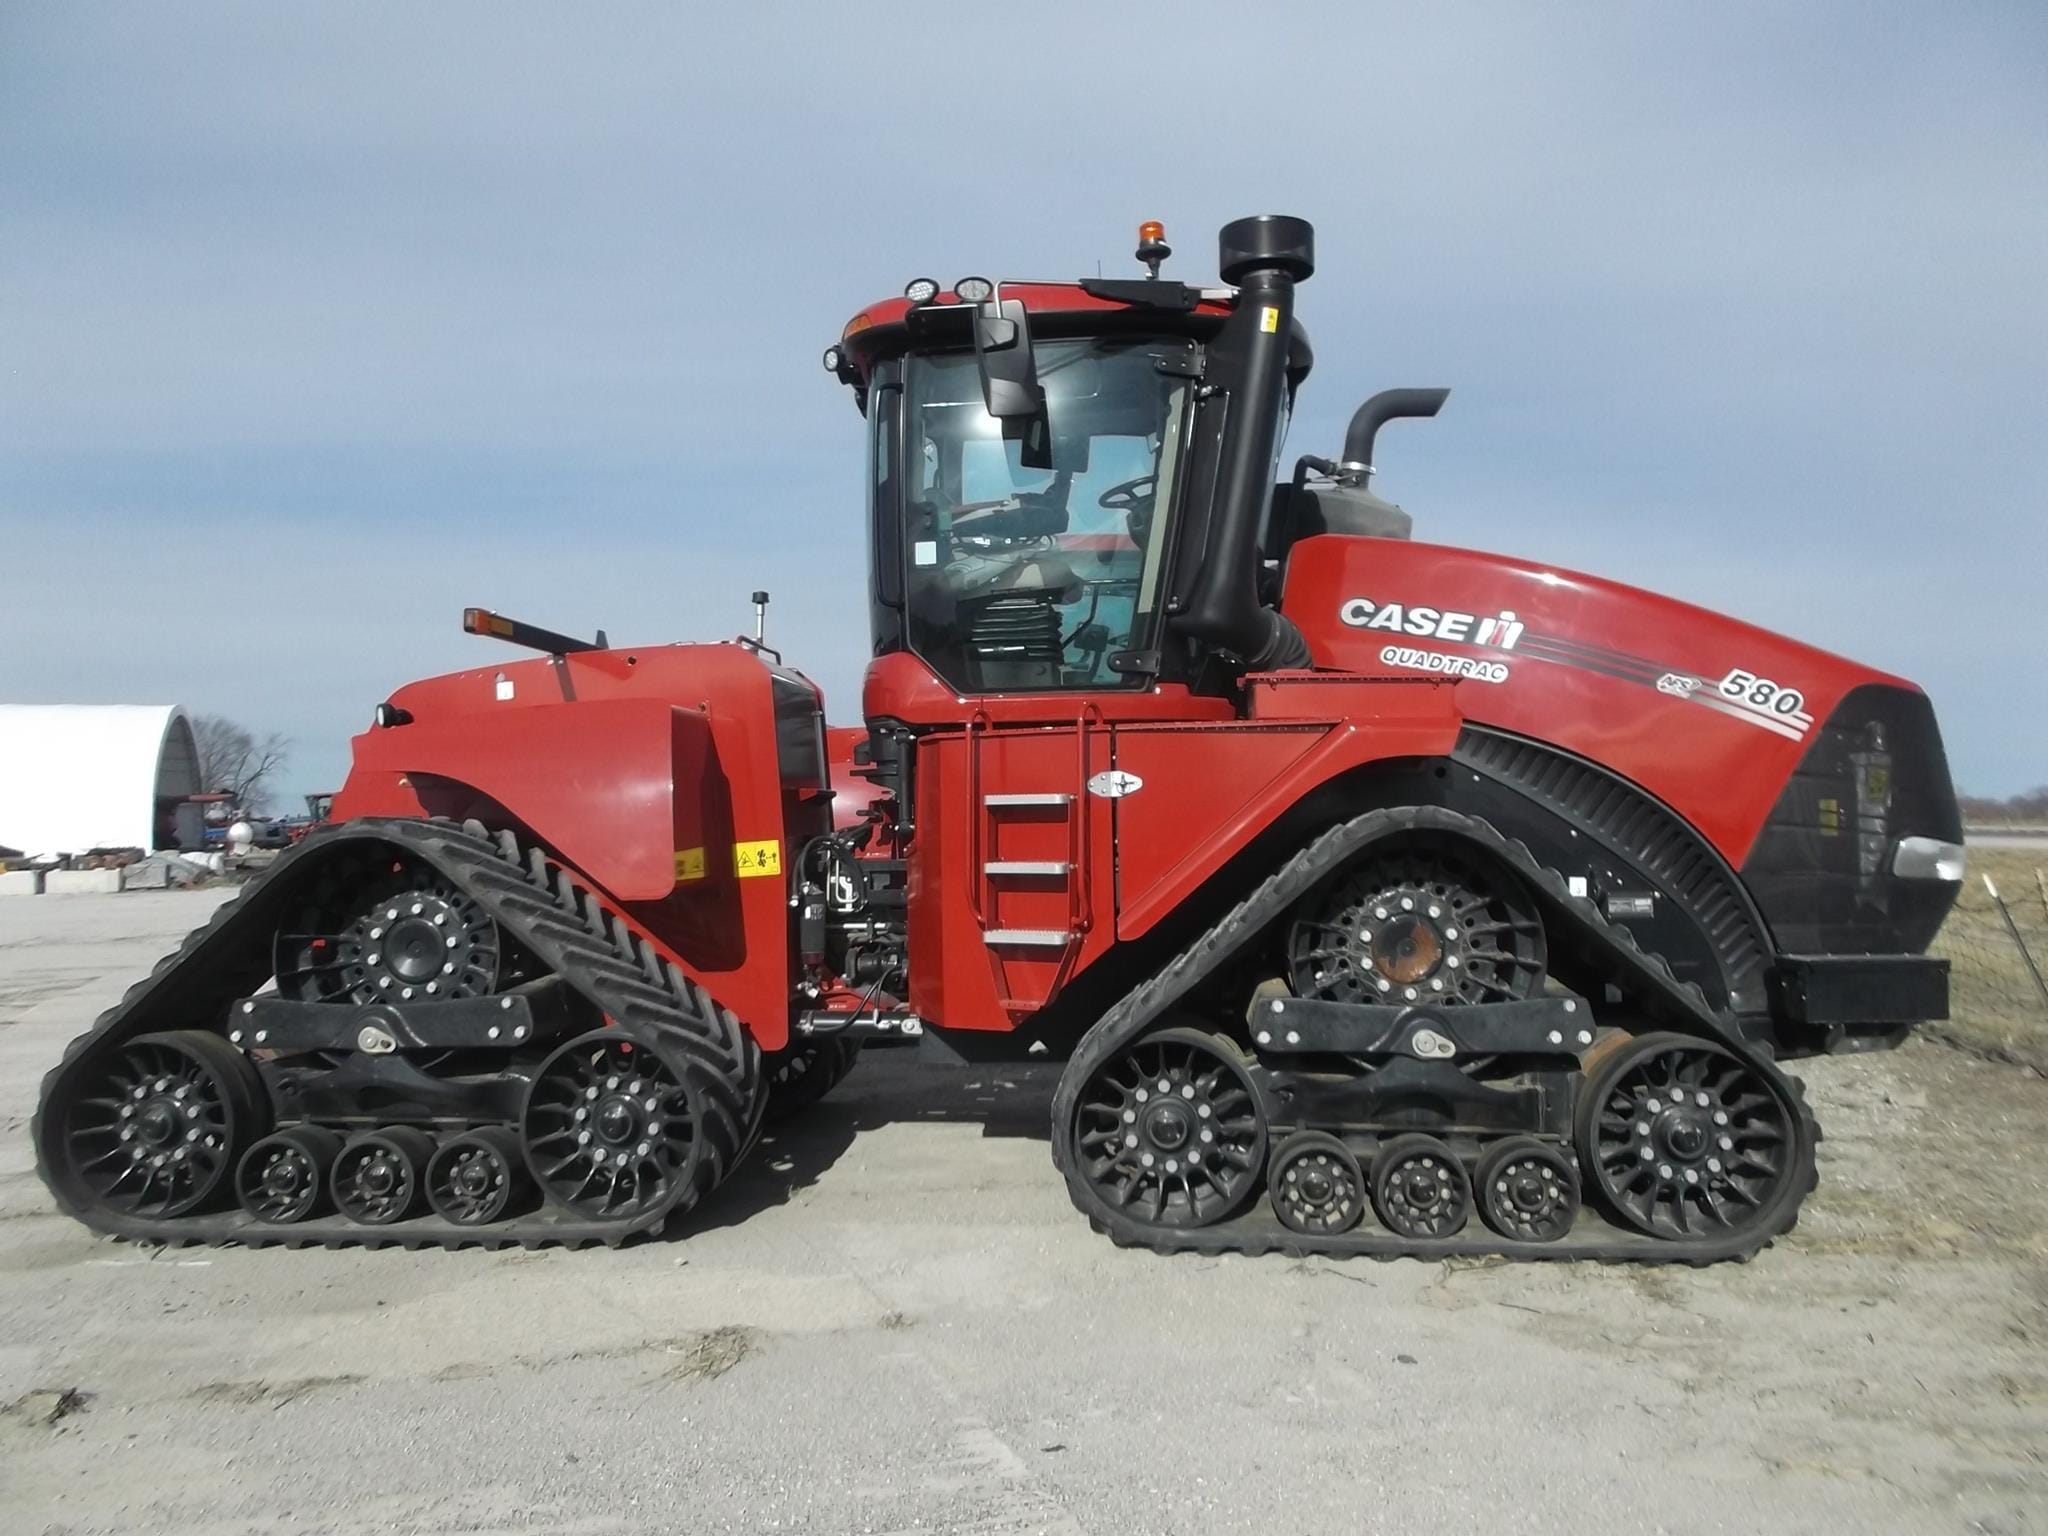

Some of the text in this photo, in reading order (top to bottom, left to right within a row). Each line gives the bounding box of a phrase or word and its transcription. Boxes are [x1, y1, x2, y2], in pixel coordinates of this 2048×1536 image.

[1340, 598, 1475, 641] CASE
[1381, 647, 1507, 682] QUADTRAC
[1721, 671, 1803, 716] 580
